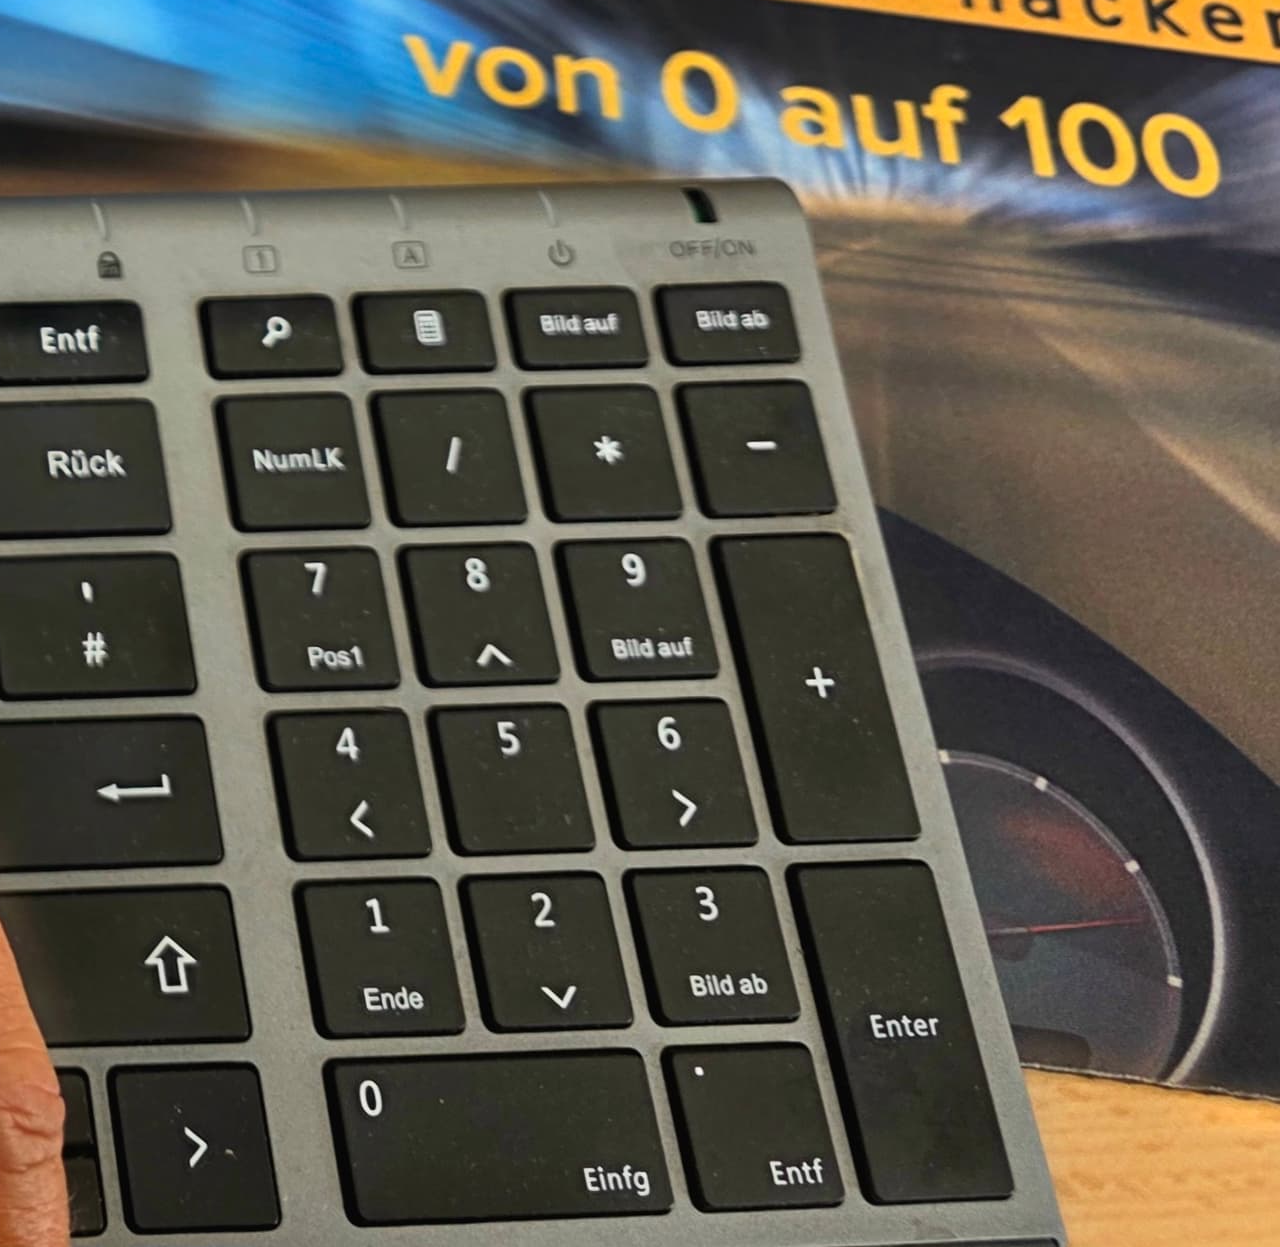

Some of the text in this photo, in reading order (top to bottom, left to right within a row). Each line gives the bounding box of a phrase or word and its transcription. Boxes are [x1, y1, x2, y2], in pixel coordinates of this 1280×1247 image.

[403, 31, 1221, 198] von 0 auf 100
[669, 239, 755, 259] OFF/ON
[540, 313, 617, 333] Bild auf
[695, 310, 769, 329] Bild ab
[40, 324, 99, 354] Entf
[47, 449, 126, 477] Rück
[252, 447, 344, 471] NumLK
[304, 562, 327, 594] 7
[465, 557, 490, 592] 8
[621, 553, 646, 587] 9
[81, 631, 107, 665] #
[307, 645, 363, 668] Pos1
[611, 636, 693, 659] Bild auf
[335, 727, 359, 760] 4
[497, 721, 520, 755] 5
[657, 716, 681, 750] 6
[365, 898, 390, 933] 1
[531, 892, 556, 927] 2
[695, 886, 719, 921] 3
[363, 986, 424, 1011] Ende
[689, 973, 768, 997] Bild ab
[869, 1014, 939, 1039] Enter
[359, 1080, 383, 1117] 0
[583, 1164, 650, 1197] Einfg
[769, 1157, 823, 1186] Entf
